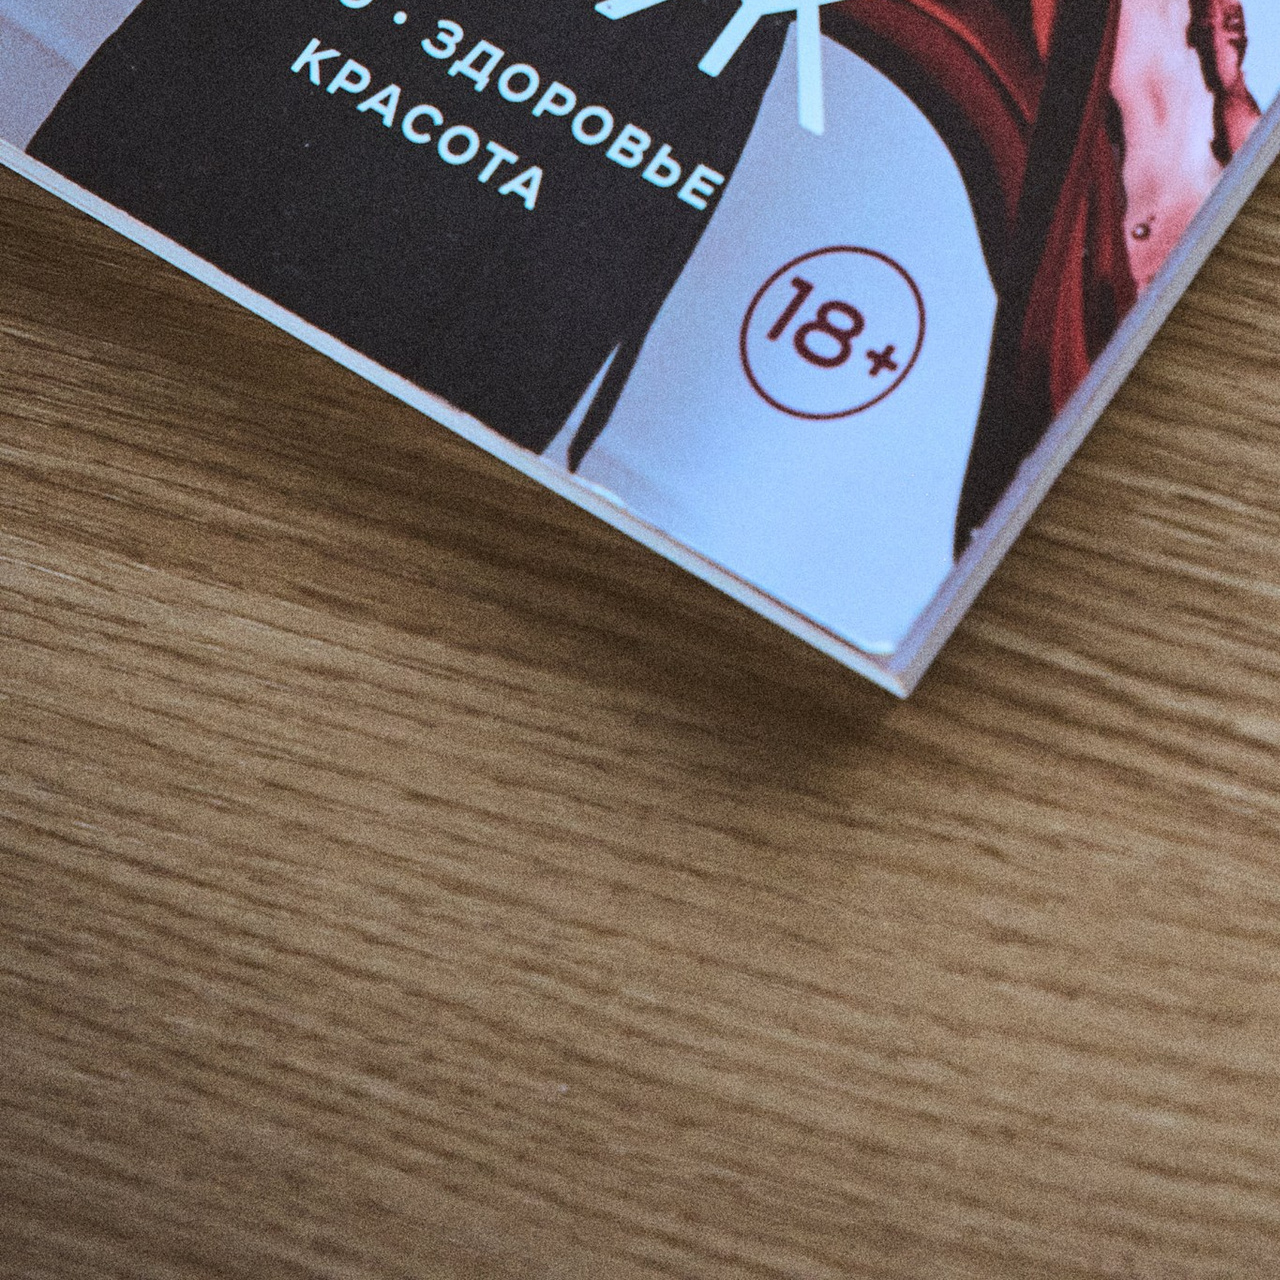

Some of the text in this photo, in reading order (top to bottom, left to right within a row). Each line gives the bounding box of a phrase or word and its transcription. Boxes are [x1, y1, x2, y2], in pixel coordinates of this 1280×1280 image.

[290, 37, 545, 211] КРАСОТА
[421, 19, 726, 210] ЗДОРОВЬЕ
[765, 278, 901, 378] 18+
